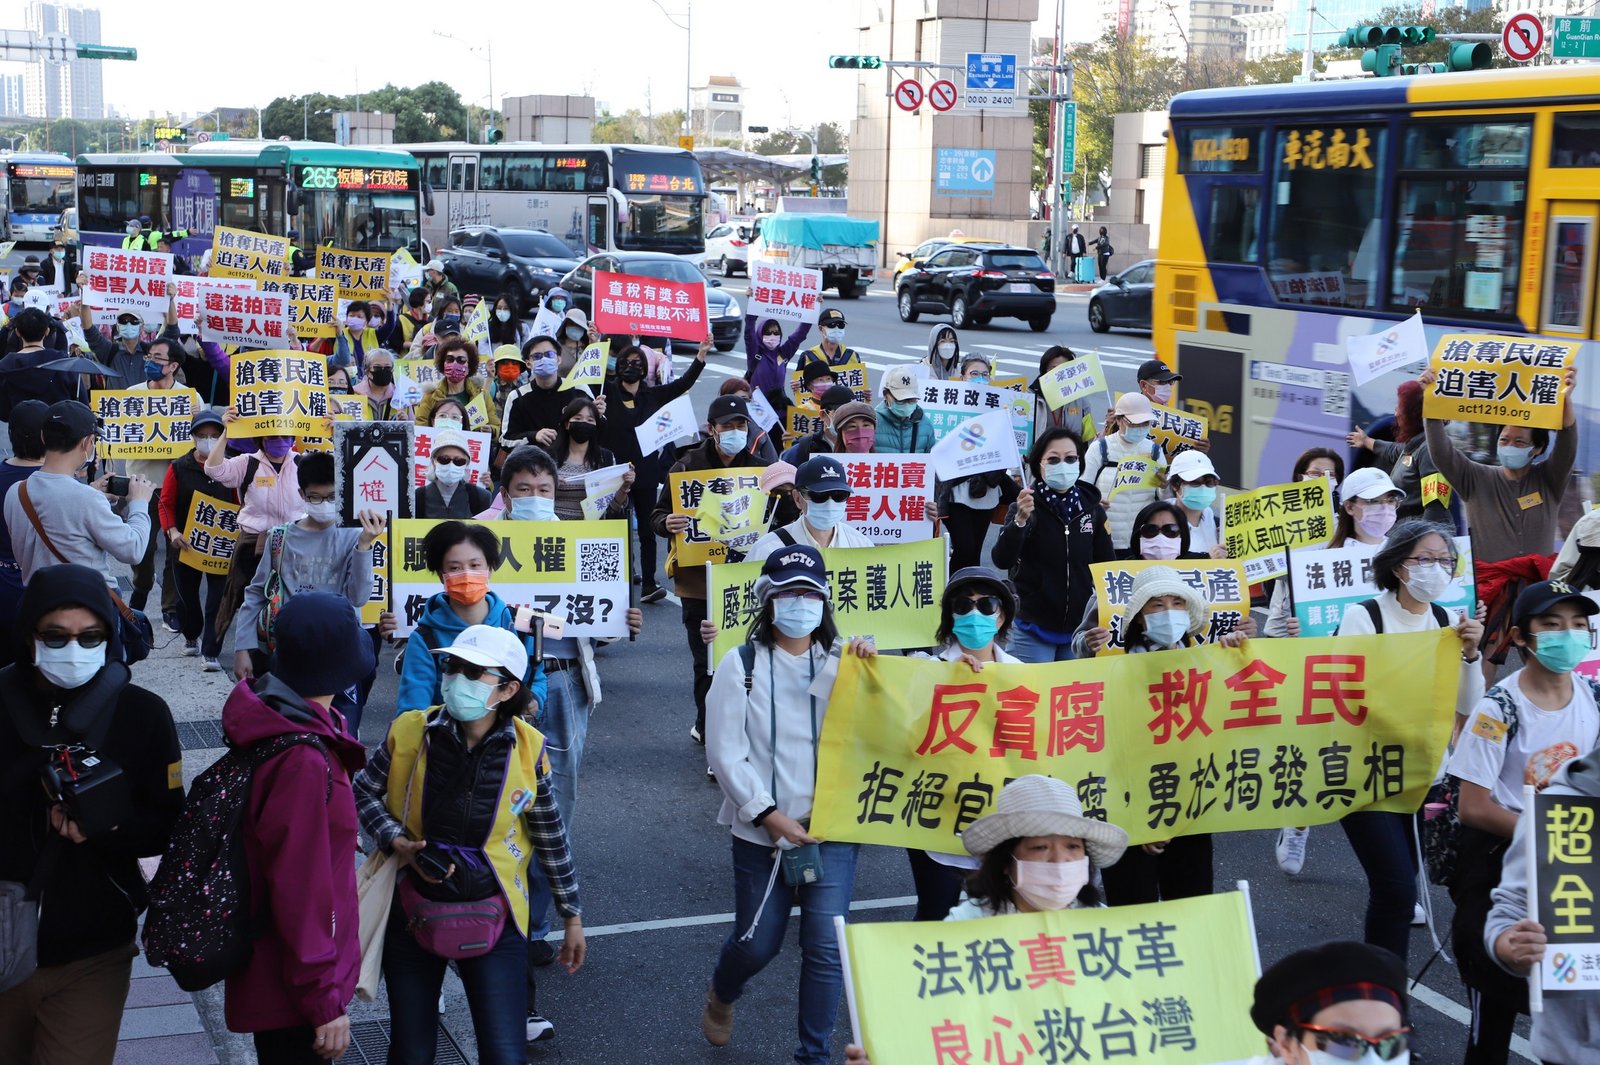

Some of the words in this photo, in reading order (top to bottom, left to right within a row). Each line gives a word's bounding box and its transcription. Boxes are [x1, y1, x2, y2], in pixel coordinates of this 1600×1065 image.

[968, 64, 1014, 73] 公車專用
[302, 166, 338, 189] 265
[338, 168, 364, 185] 板橋
[369, 170, 408, 186] 行政院
[670, 176, 694, 191] 台北
[220, 231, 285, 257] 搶奪民產
[89, 252, 167, 276] 違法拍賣
[216, 250, 283, 276] 迫害人權
[321, 252, 386, 272] 搶奪民產
[89, 274, 166, 298] 迫害人權
[228, 270, 258, 280] act1219.
[756, 266, 817, 290] 違法拍賣
[104, 297, 150, 308] act1219.org
[608, 280, 691, 304] 查稅有獎金
[754, 286, 816, 310] 迫害人權
[204, 292, 283, 317] 違法拍賣
[600, 298, 700, 323] 烏龍稅單數不清
[764, 308, 802, 319] act1219.org
[206, 315, 283, 338] 迫害人權
[222, 335, 268, 347] act1219.org
[1442, 340, 1568, 370] 搶奪民產
[235, 357, 325, 387] 搶奪民產
[924, 386, 1000, 408] 法稅改革
[1434, 368, 1562, 406] 迫害人權
[98, 394, 192, 418] 搶奪民產
[235, 390, 327, 418] 迫害人權
[1458, 402, 1531, 420] act1219.org
[98, 420, 193, 444] 迫害人權
[254, 419, 311, 431] act1219.org
[118, 444, 172, 454] act1219.org
[359, 455, 388, 502] 人權
[846, 462, 926, 489] 法拍賣
[1423, 480, 1451, 498] 糾察
[844, 495, 926, 522] 害人權
[403, 536, 566, 573] 賦人權
[780, 552, 816, 568] NCTU
[866, 560, 934, 612] 護人權
[1550, 580, 1573, 596] NY
[915, 680, 1105, 761] 反貪腐
[1147, 654, 1368, 745] 救全民
[913, 921, 1184, 999] 法稅真改革
[931, 995, 1197, 1065] 良心救台灣
